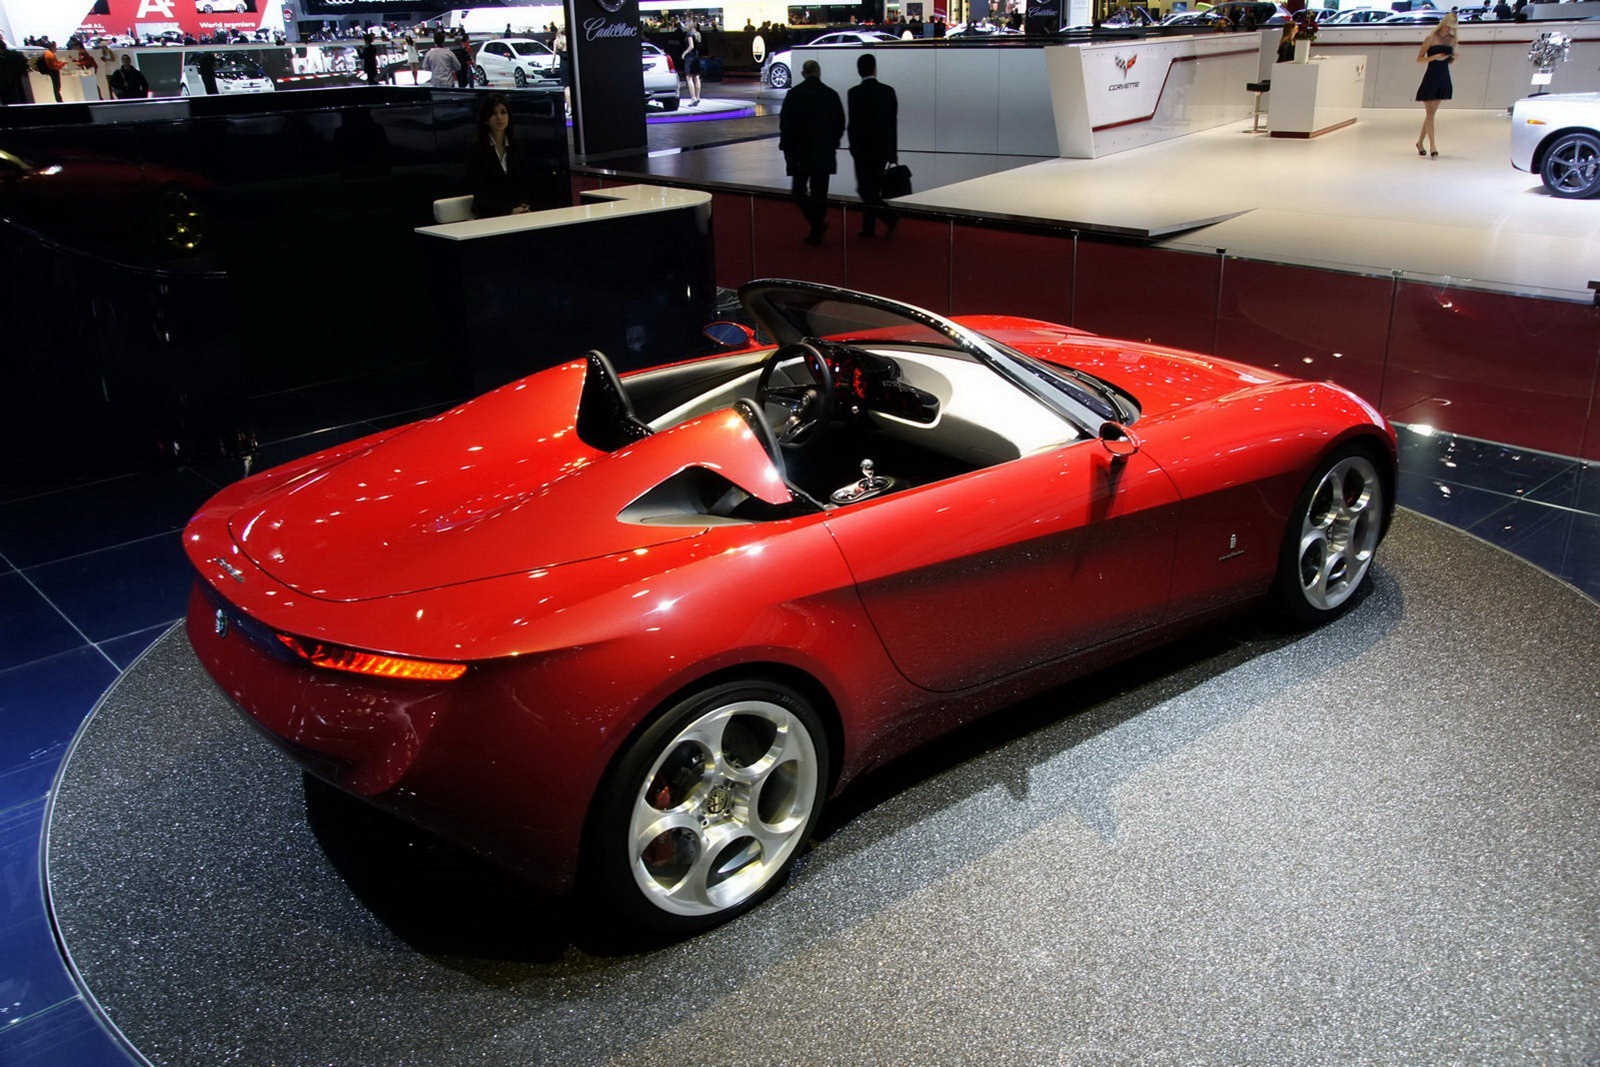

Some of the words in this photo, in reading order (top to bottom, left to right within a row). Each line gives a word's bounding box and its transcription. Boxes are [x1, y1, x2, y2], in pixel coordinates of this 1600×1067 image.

[1028, 6, 1058, 17] Cadillac
[583, 17, 637, 42] Cadillac
[1108, 81, 1140, 91] CORVETTE
